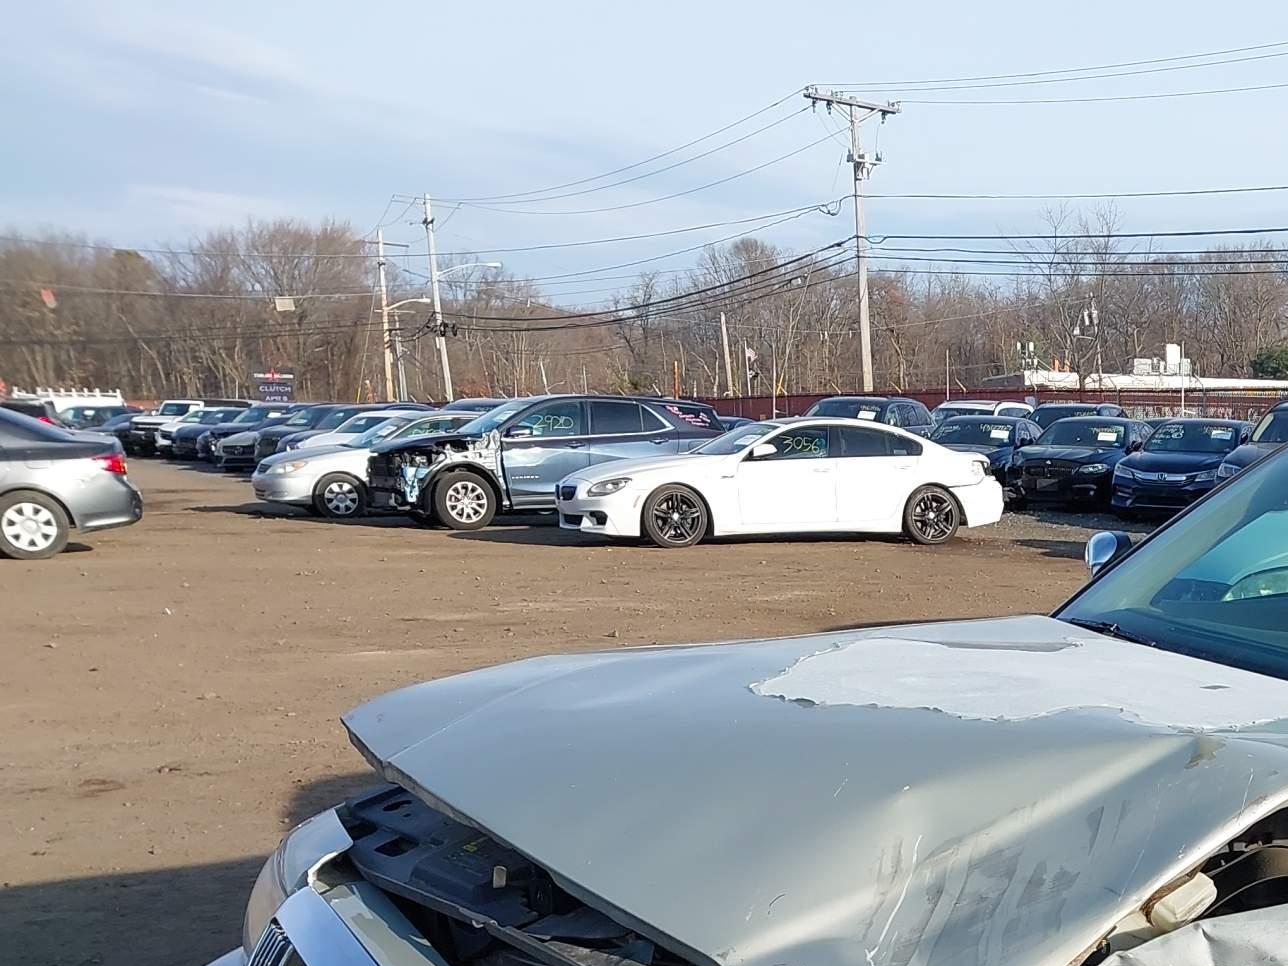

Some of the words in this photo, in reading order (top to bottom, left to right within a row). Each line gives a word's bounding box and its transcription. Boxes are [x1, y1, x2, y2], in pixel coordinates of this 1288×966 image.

[259, 385, 291, 393] CLUTCH
[531, 414, 574, 432] 2920
[780, 435, 820, 454] 3056
